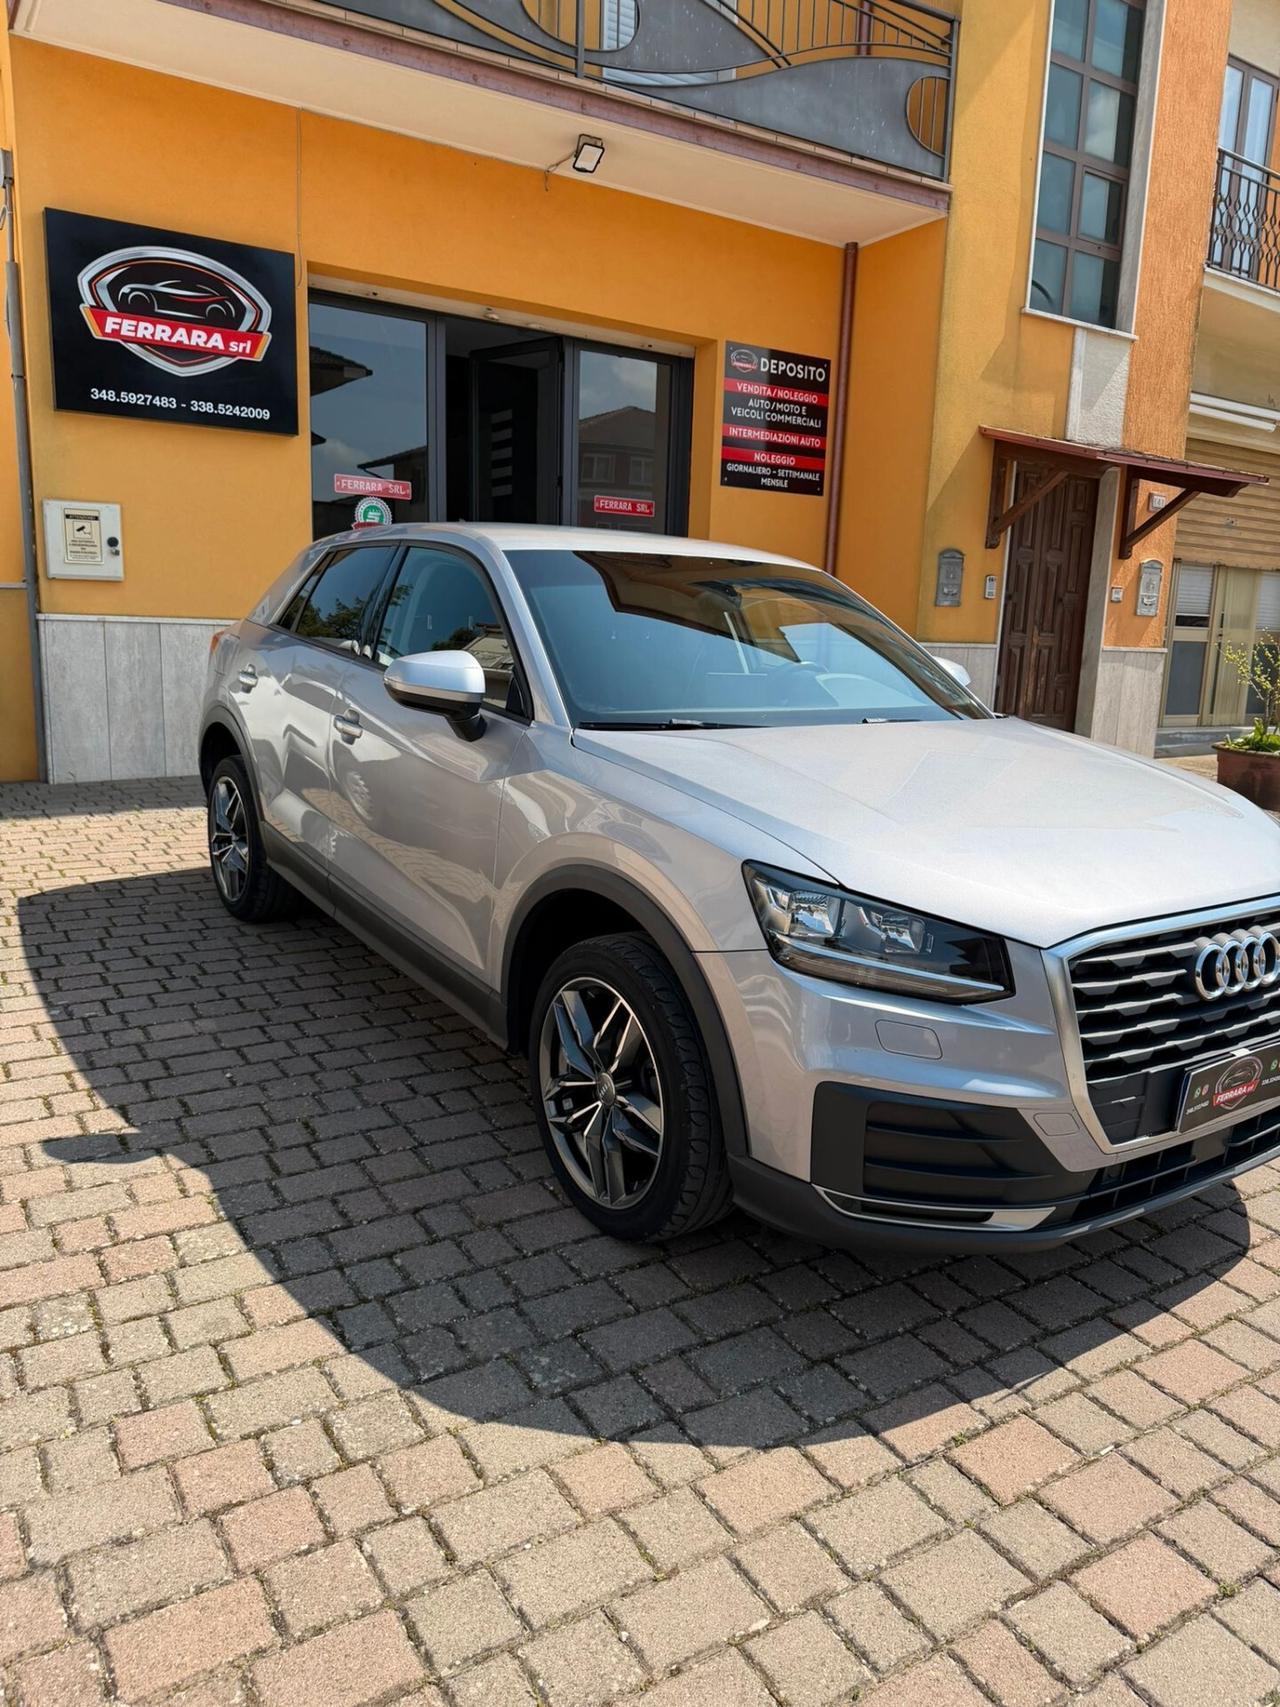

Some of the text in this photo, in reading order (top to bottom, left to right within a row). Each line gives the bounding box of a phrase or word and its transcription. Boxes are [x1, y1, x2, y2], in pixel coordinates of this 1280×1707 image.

[104, 316, 251, 354] FERRARA srl
[760, 357, 826, 382] DEPOSITO
[736, 382, 818, 404] VENDITA/NOLEGGIO
[90, 388, 177, 409] 348.5927483
[190, 400, 270, 420] 338.5242009
[801, 406, 807, 415] E
[731, 406, 822, 428] VEICOLI COMMERCIALI
[729, 427, 821, 447] INTERMEDIAZIONI AUTO
[754, 452, 796, 465] NOLEGGIO
[726, 463, 771, 475] GIORNALIERO
[777, 469, 820, 481] SETTIMANALE
[341, 479, 406, 495] FERRARA SRL
[760, 477, 789, 488] MENSILE
[600, 499, 650, 512] FERRARA SRL
[1216, 1085, 1247, 1104] FERRARA
